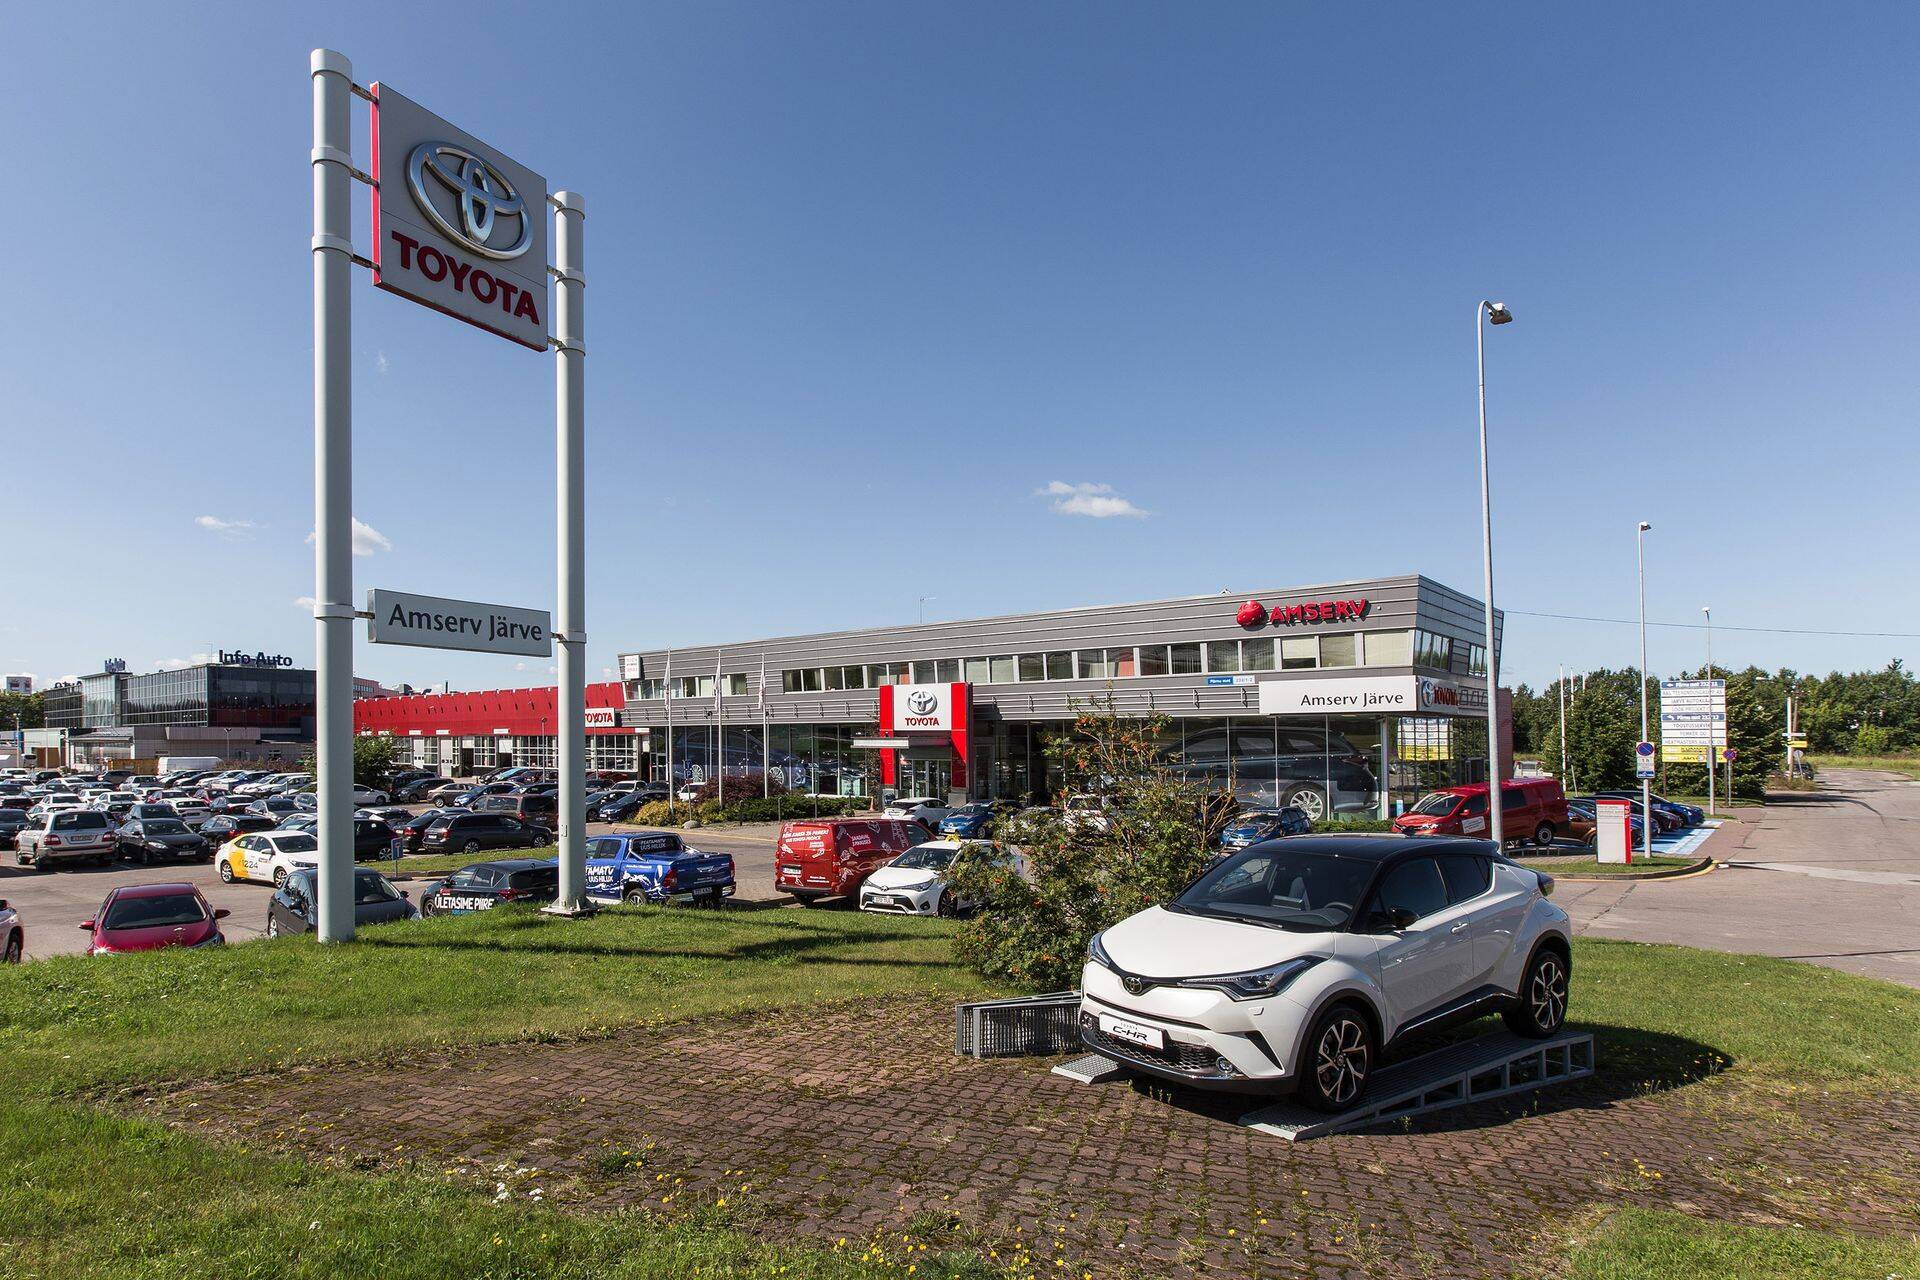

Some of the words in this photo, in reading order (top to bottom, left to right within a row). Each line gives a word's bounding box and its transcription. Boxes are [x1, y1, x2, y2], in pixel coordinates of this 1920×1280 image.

[391, 230, 540, 326] TOYOTA
[1268, 598, 1367, 623] AMSERV
[388, 603, 482, 635] Amserv
[488, 615, 542, 642] Järve
[218, 649, 293, 667] Info-Auto
[1300, 693, 1358, 706] Amserv
[1363, 692, 1404, 707] Järve
[904, 717, 940, 726] TOYOTA
[588, 875, 599, 883] UUS
[599, 875, 613, 883] HILUX
[434, 894, 474, 910] ÜLETASIME
[1112, 1025, 1148, 1042] C-HR
